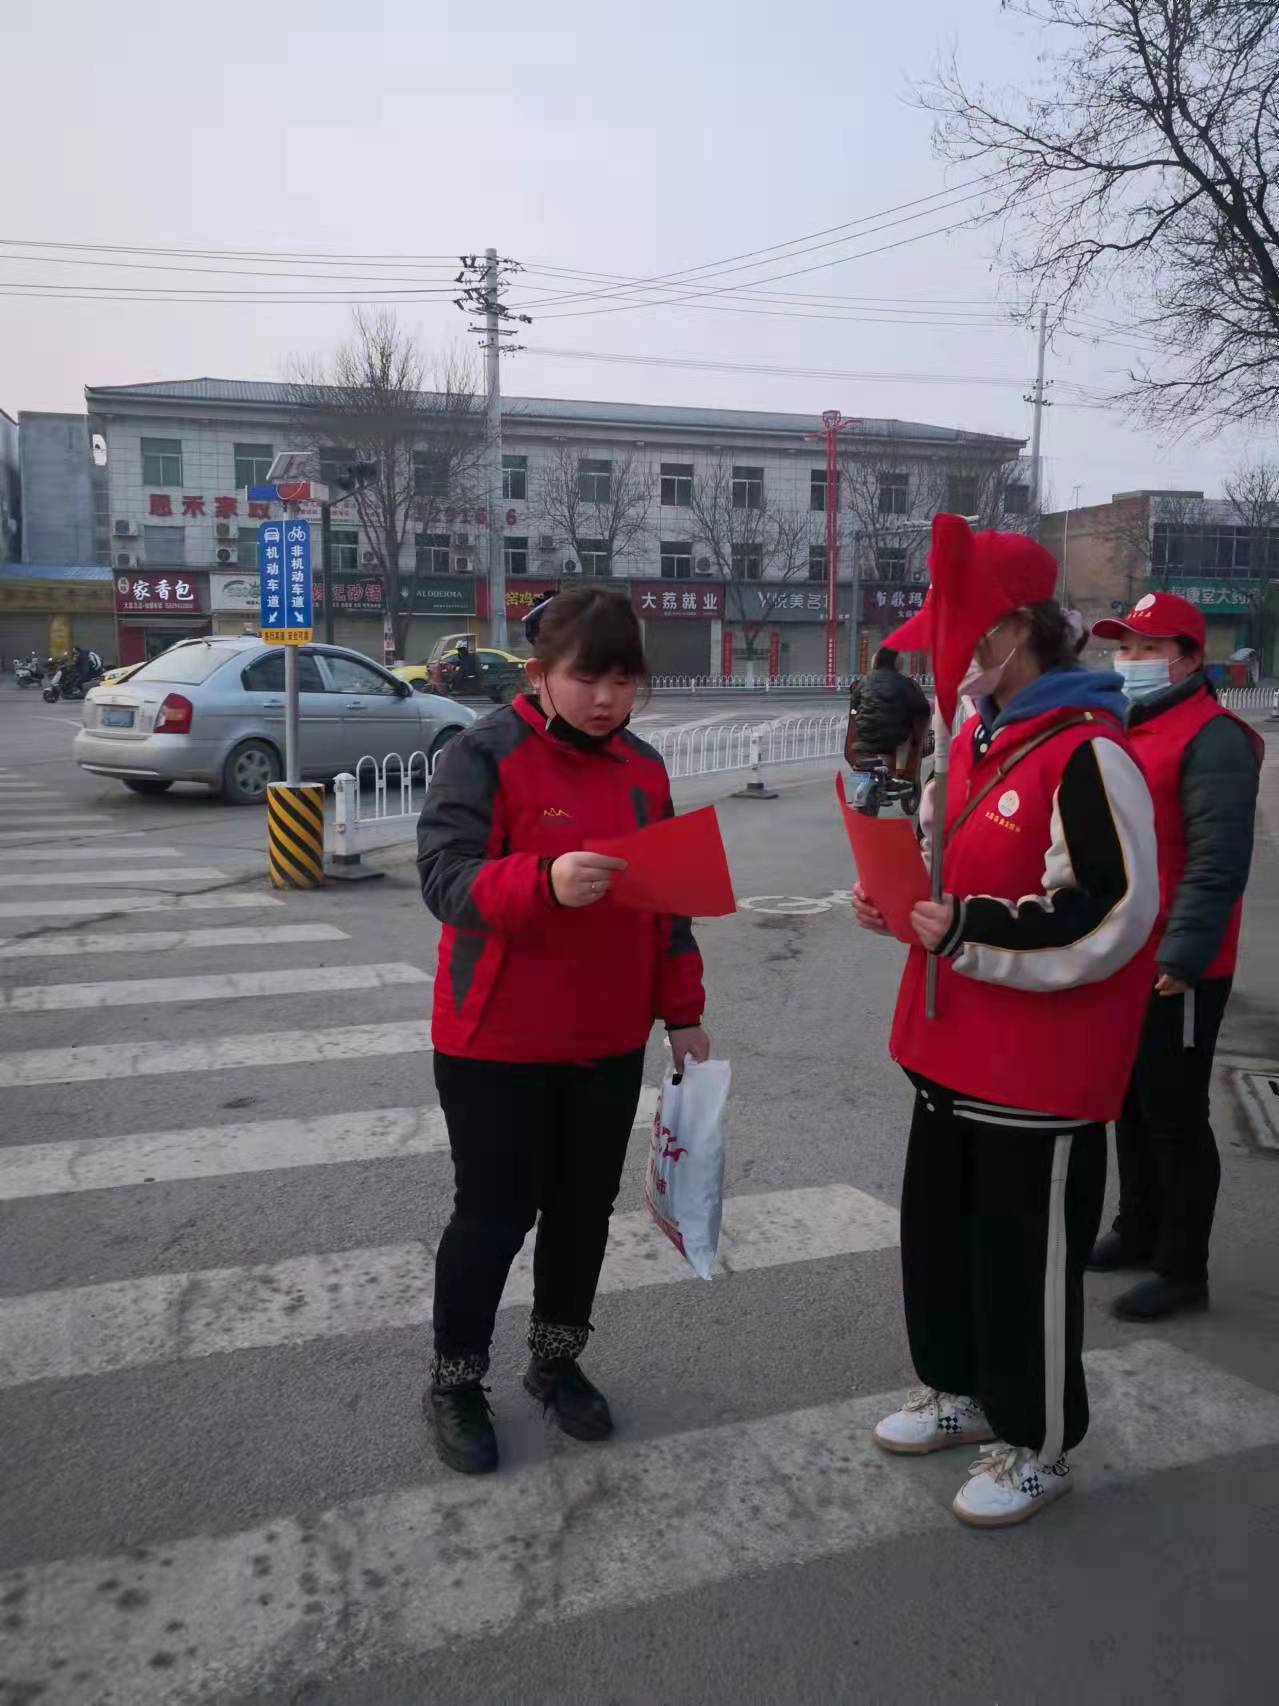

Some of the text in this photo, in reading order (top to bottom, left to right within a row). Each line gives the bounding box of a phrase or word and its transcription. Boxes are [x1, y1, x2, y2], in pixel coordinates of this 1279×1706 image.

[132, 579, 194, 601] 家香包
[265, 546, 279, 608] 机动车道
[290, 545, 305, 608] 非机动车道
[641, 592, 718, 611] 大荔就业
